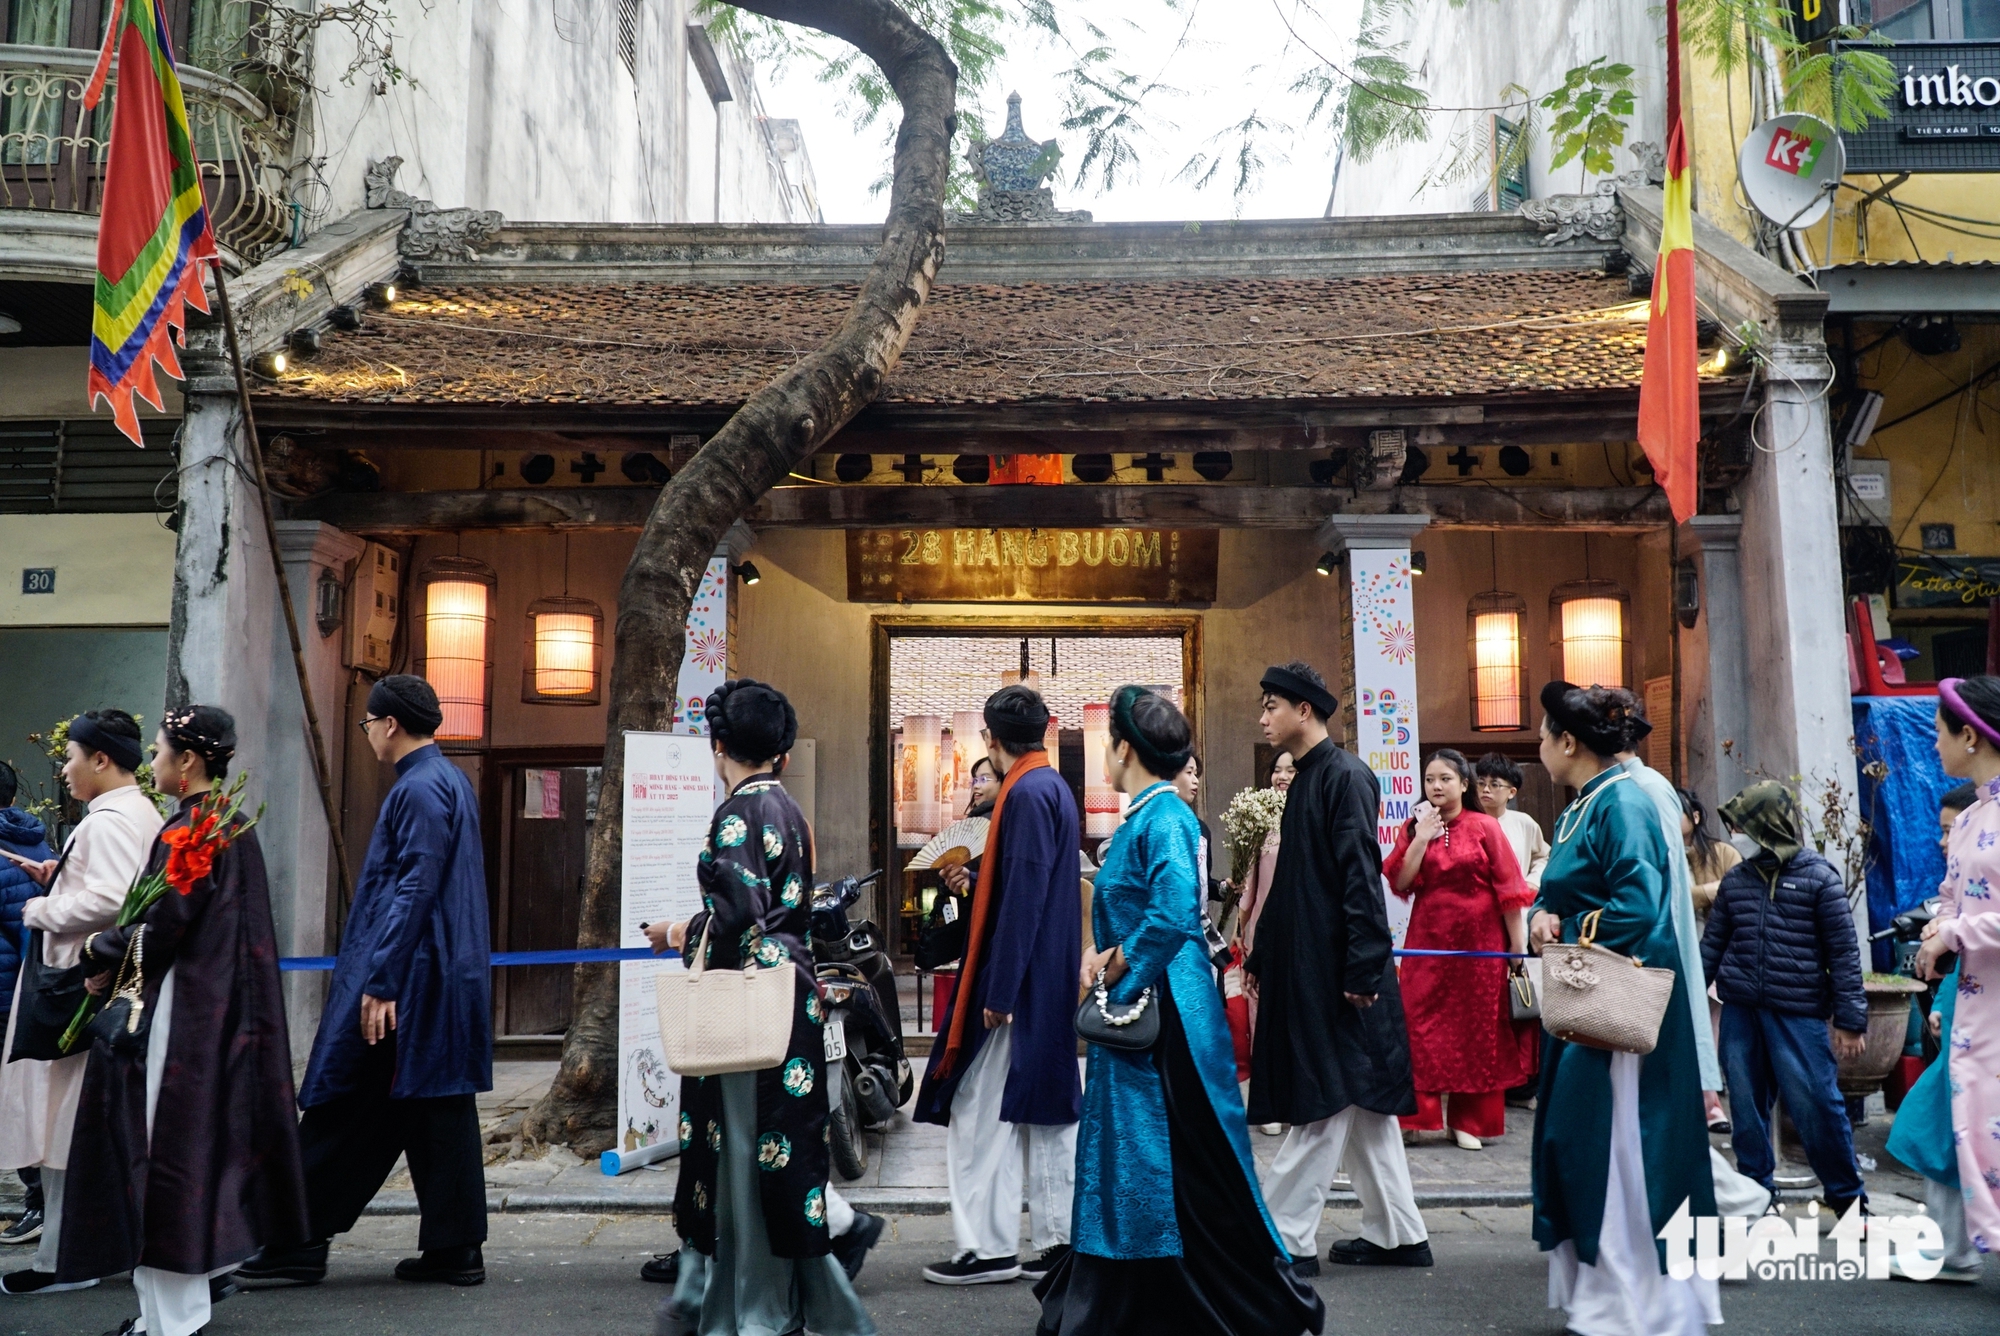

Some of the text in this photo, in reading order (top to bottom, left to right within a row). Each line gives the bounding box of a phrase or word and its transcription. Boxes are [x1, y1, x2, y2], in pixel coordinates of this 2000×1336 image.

[1771, 135, 1814, 167] K+
[900, 530, 942, 565] 28
[1927, 529, 1949, 545] 26
[29, 573, 50, 590] 30
[1898, 563, 2000, 603] Tattoo Stu
[1369, 747, 1410, 771] CHÚC
[825, 1041, 842, 1058] 05
